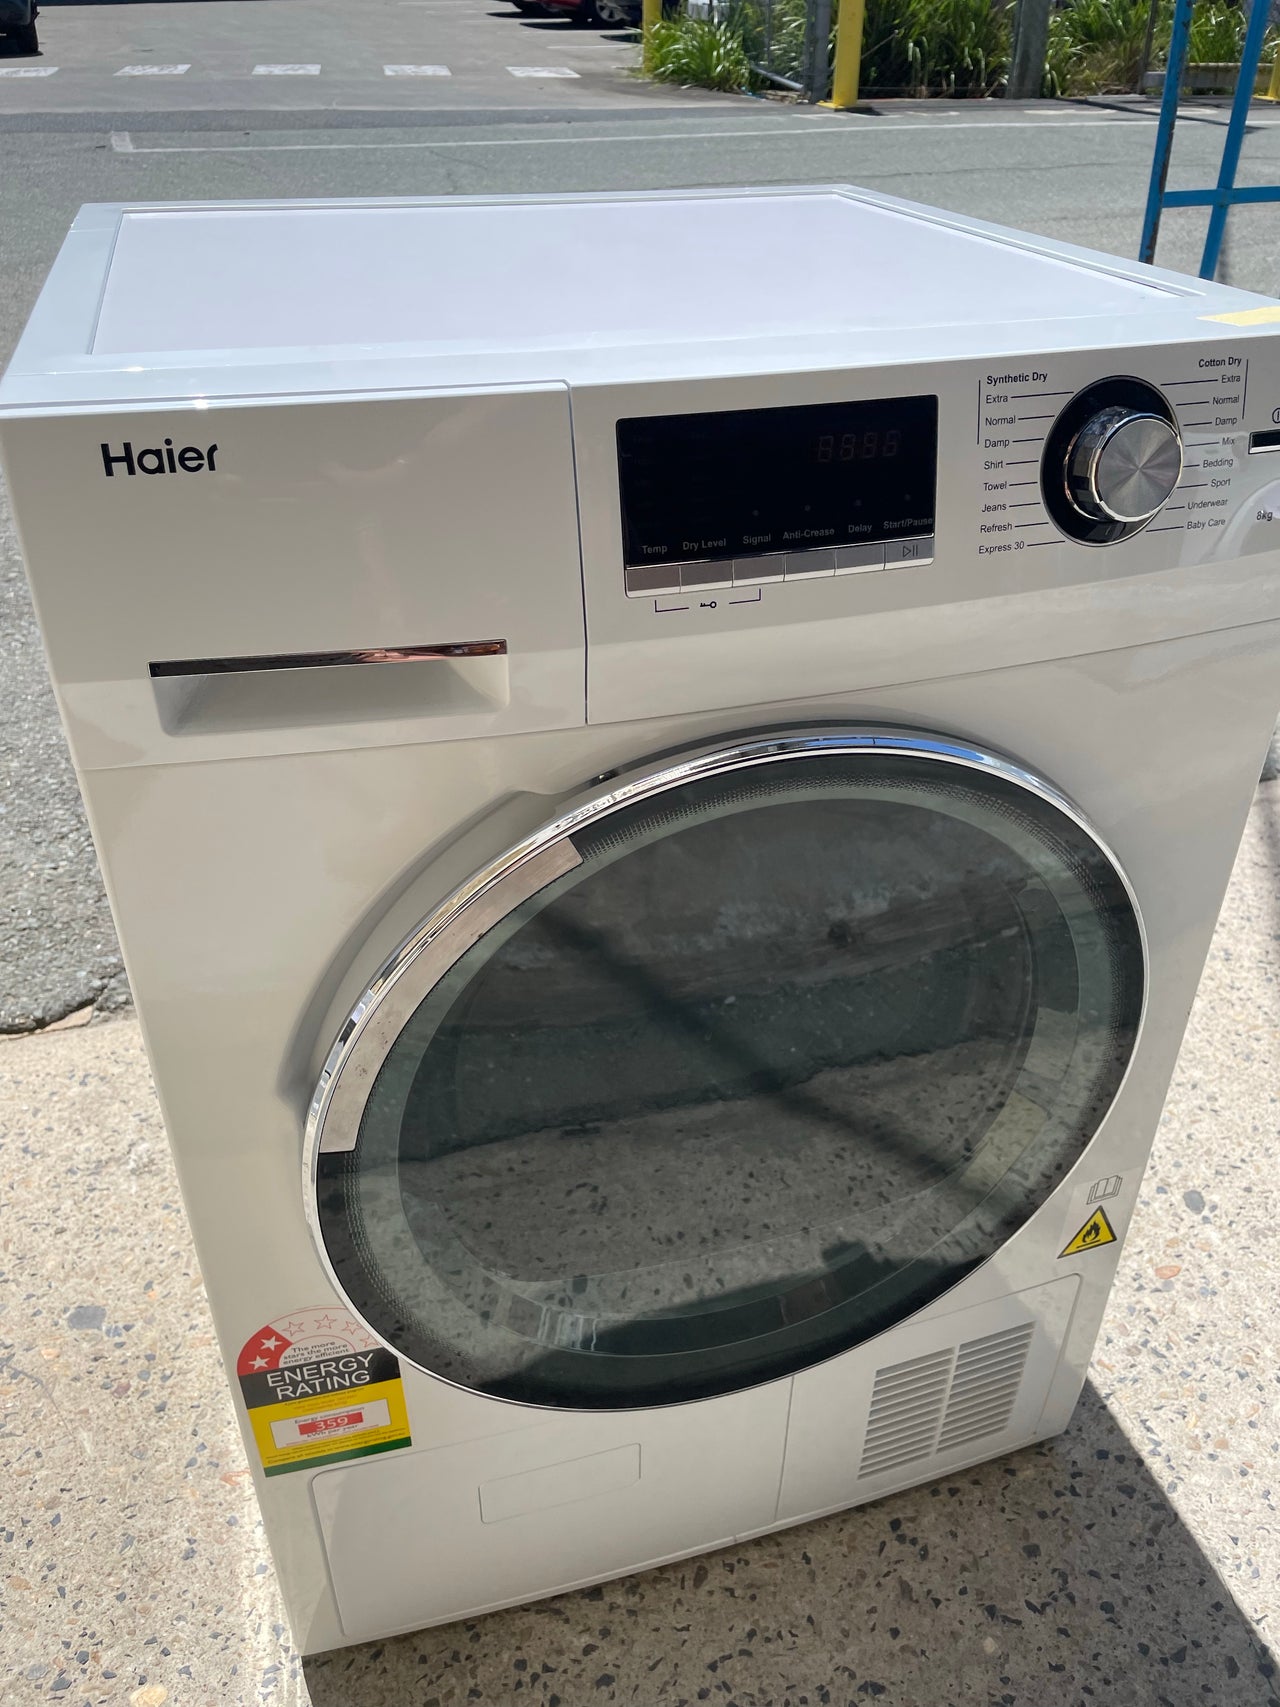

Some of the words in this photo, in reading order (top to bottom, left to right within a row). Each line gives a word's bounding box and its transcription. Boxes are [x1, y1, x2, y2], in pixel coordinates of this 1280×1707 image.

[1198, 357, 1226, 368] Cotton
[1227, 356, 1242, 367] Dry
[986, 373, 1030, 385] Synthetic
[1031, 371, 1048, 383] Dry
[1221, 374, 1241, 383] Extra
[985, 393, 1008, 404] Extra
[1212, 394, 1240, 405] Normal
[985, 415, 1016, 426] Normal
[1214, 416, 1237, 428] Damp
[984, 437, 1010, 450] Damp
[1222, 436, 1235, 445] Mix
[101, 438, 218, 476] Haier
[1202, 457, 1234, 469] Bedding
[984, 459, 1004, 470] Shirt
[983, 480, 1007, 491] Towel
[1210, 477, 1231, 489] Sport
[981, 502, 1007, 513] Jeans
[1187, 498, 1228, 510] Underwear
[1256, 510, 1273, 522] 8kg
[848, 522, 873, 534] Delay
[883, 516, 933, 530] Start/Pause
[980, 522, 1013, 534] Refresh
[1187, 520, 1206, 532] Baby
[1207, 517, 1226, 528] Care
[742, 533, 771, 545] Signal
[782, 527, 835, 540] Anti-Crease
[641, 544, 668, 556] Temp
[682, 541, 701, 552] Dry
[701, 538, 726, 550] Level
[978, 543, 1012, 555] Express
[1013, 540, 1025, 550] 30
[311, 1341, 336, 1350] more
[283, 1355, 313, 1365] energy
[266, 1353, 374, 1387] ENERGY
[276, 1370, 370, 1400] RATING
[315, 1416, 348, 1431] 359
